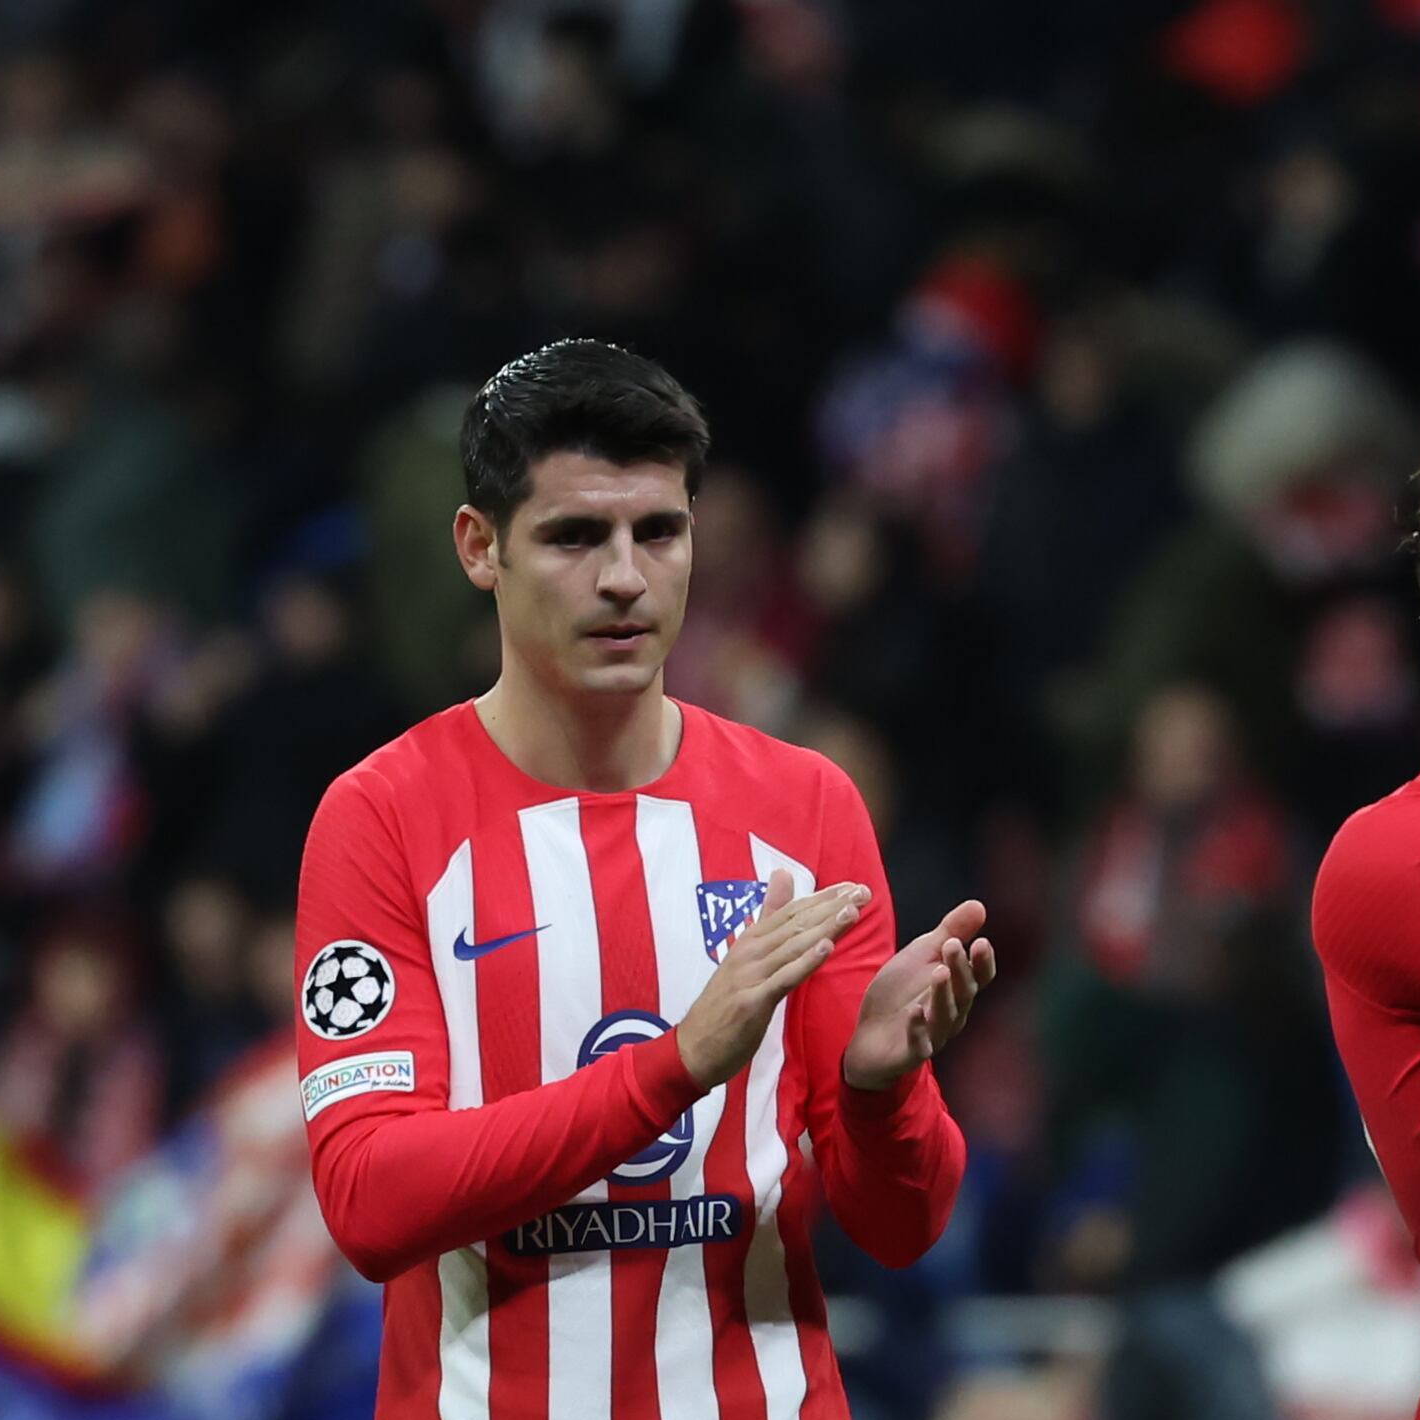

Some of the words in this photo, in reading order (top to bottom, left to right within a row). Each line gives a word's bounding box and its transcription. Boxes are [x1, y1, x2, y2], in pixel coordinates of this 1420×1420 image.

[304, 1064, 412, 1106] FOUNDATION
[517, 1206, 677, 1250] RIYADH
[681, 1200, 732, 1239] AIR
